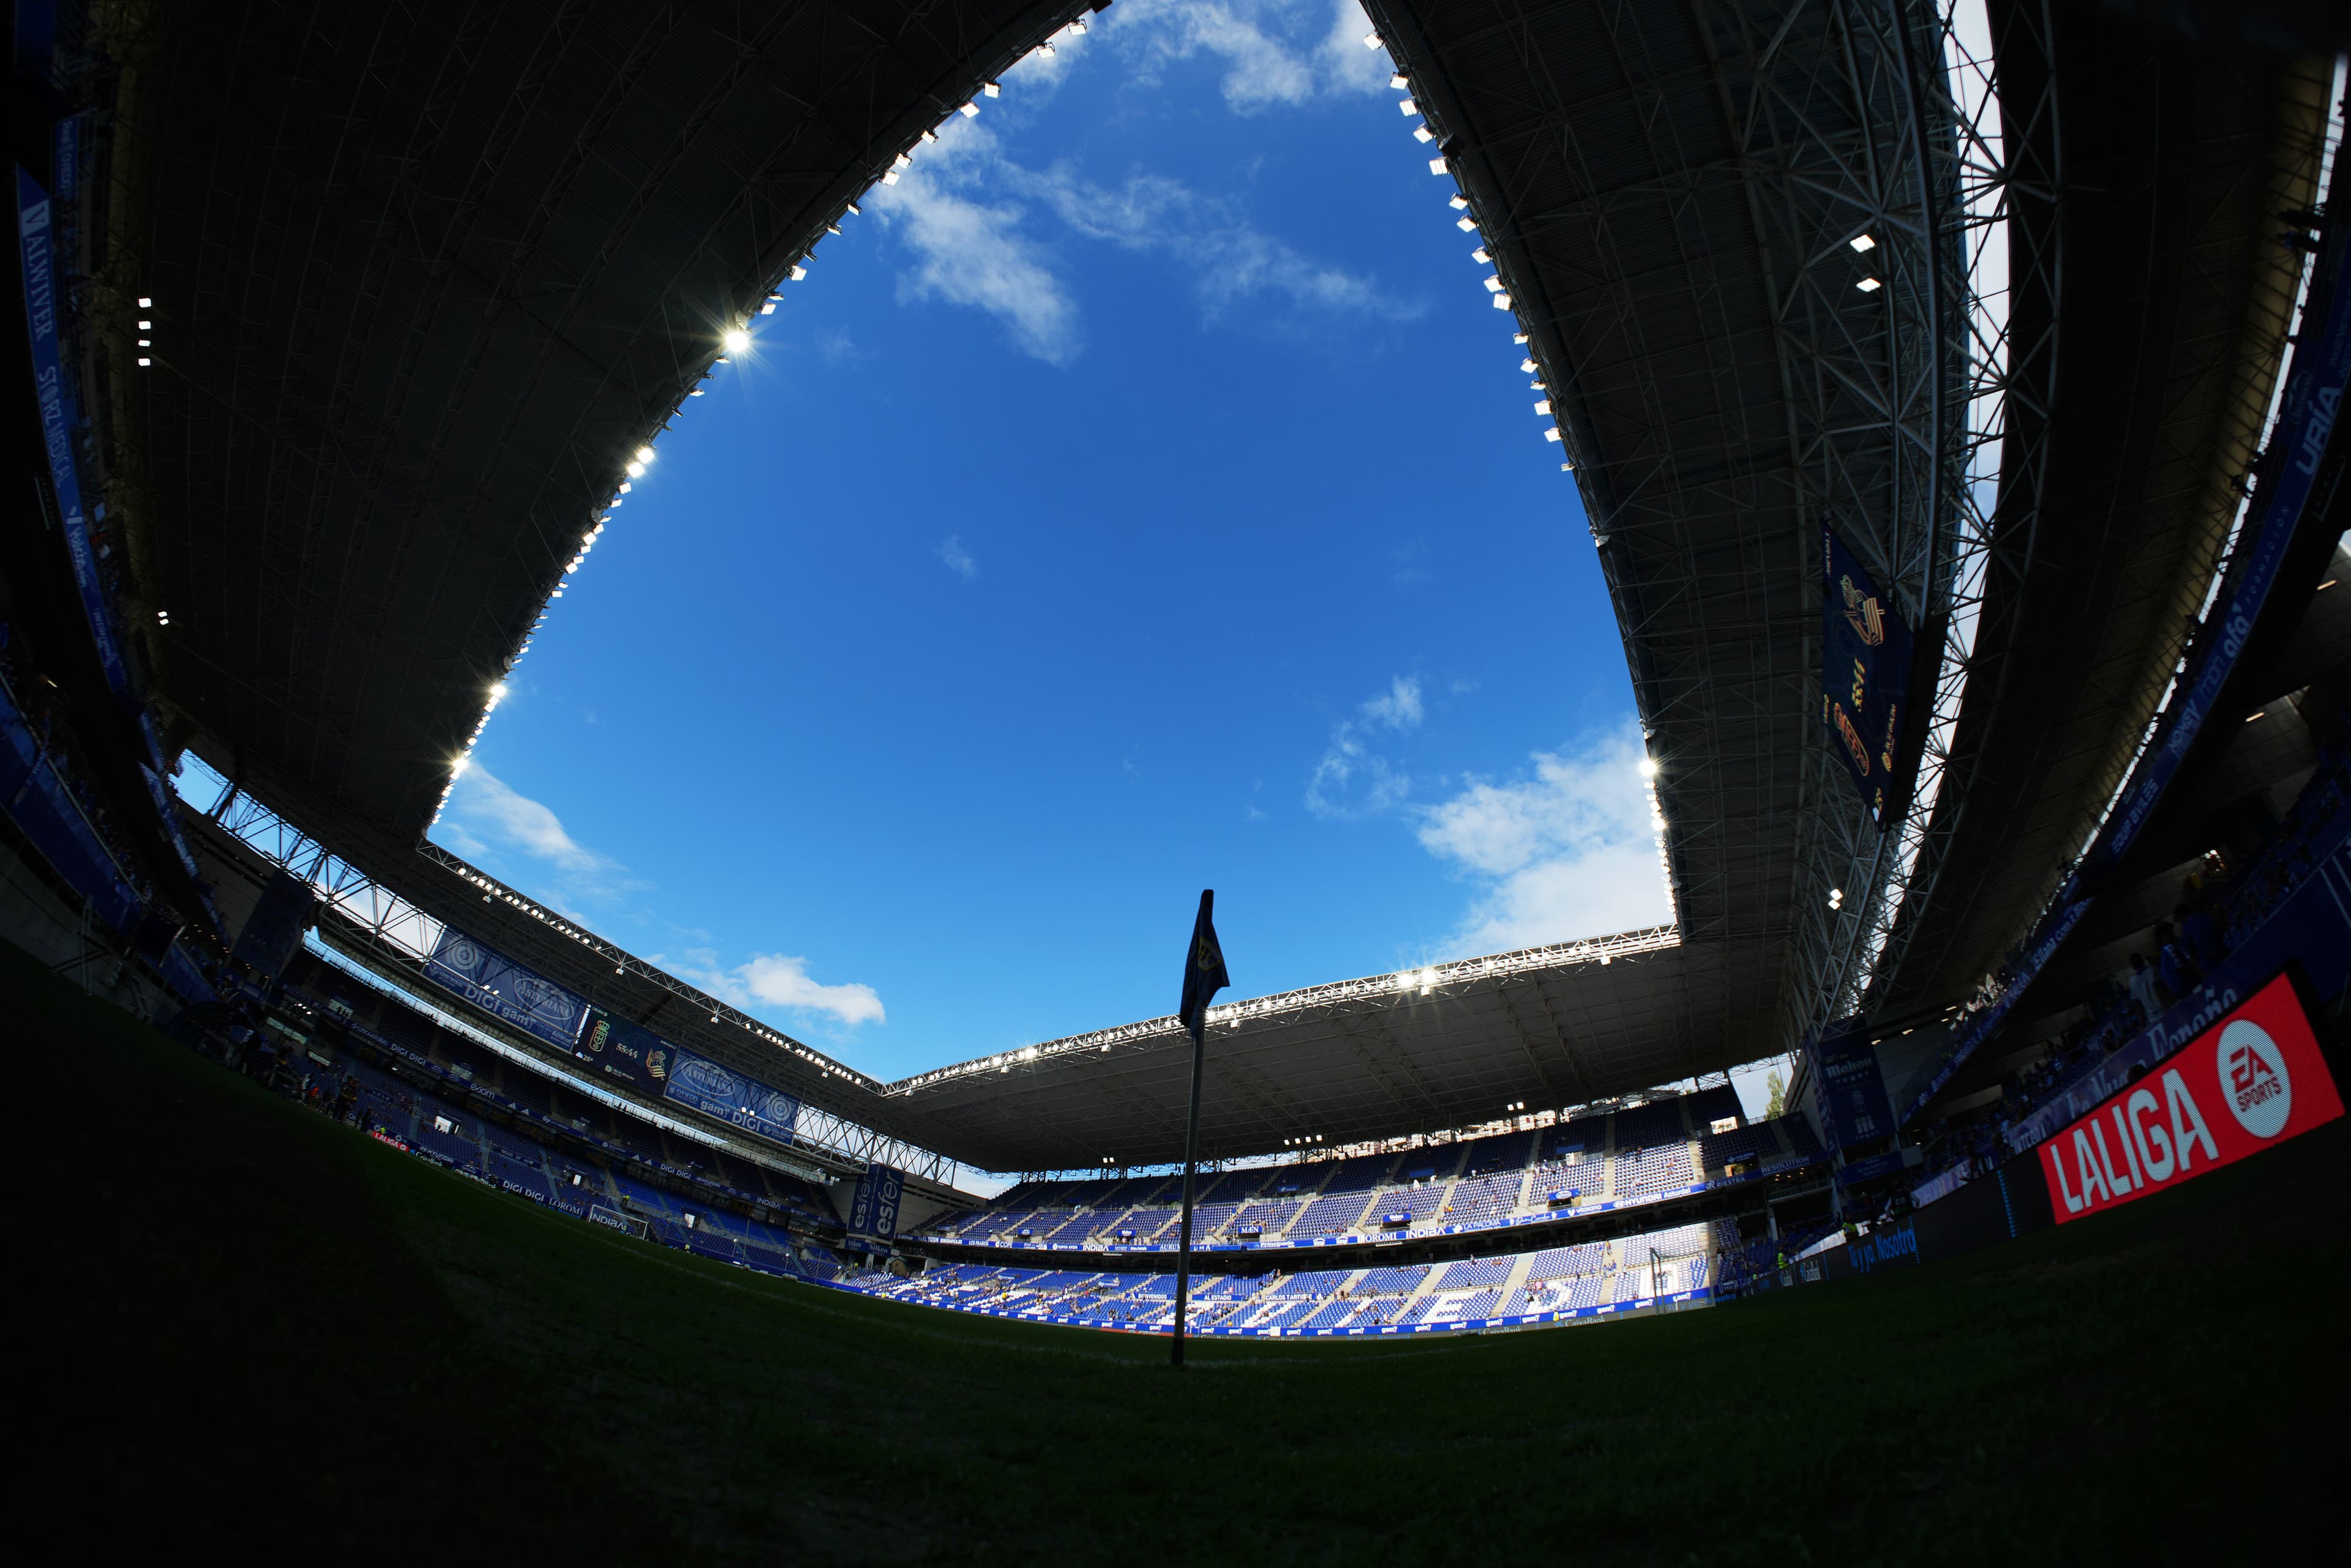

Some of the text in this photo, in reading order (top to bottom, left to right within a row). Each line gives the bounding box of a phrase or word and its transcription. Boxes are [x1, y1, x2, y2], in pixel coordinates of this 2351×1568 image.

[25, 234, 54, 342] ALWIVER
[2295, 386, 2342, 476] URÍA
[464, 984, 498, 1012] DIGI
[517, 981, 570, 1017] ASTURIANA
[391, 1043, 427, 1067] DIGI DIGI
[615, 1043, 639, 1059] 55:44
[684, 1067, 732, 1093] ASTURIANA
[2229, 1044, 2276, 1094] EA
[2237, 1076, 2282, 1113] SPORTS
[732, 1111, 761, 1133] DIGI
[374, 1132, 399, 1149] LALIGA
[2050, 1068, 2221, 1213] LALIGA
[660, 1163, 691, 1180] DIGI DIGI
[1761, 1155, 1810, 1174] RESOLUTION
[502, 1180, 545, 1202] DIGI DIGI
[1717, 1176, 1745, 1188] RIESTRA
[756, 1196, 781, 1210] INDIBA
[855, 1175, 871, 1229] esfer
[877, 1171, 899, 1235] esfer
[1624, 1193, 1662, 1206] HYUNDAI
[1406, 1228, 1446, 1239] INDIBA
[868, 1242, 888, 1255] Silken
[1082, 1244, 1109, 1252] INDIBA
[1565, 1316, 1607, 1327] CaixaBank
